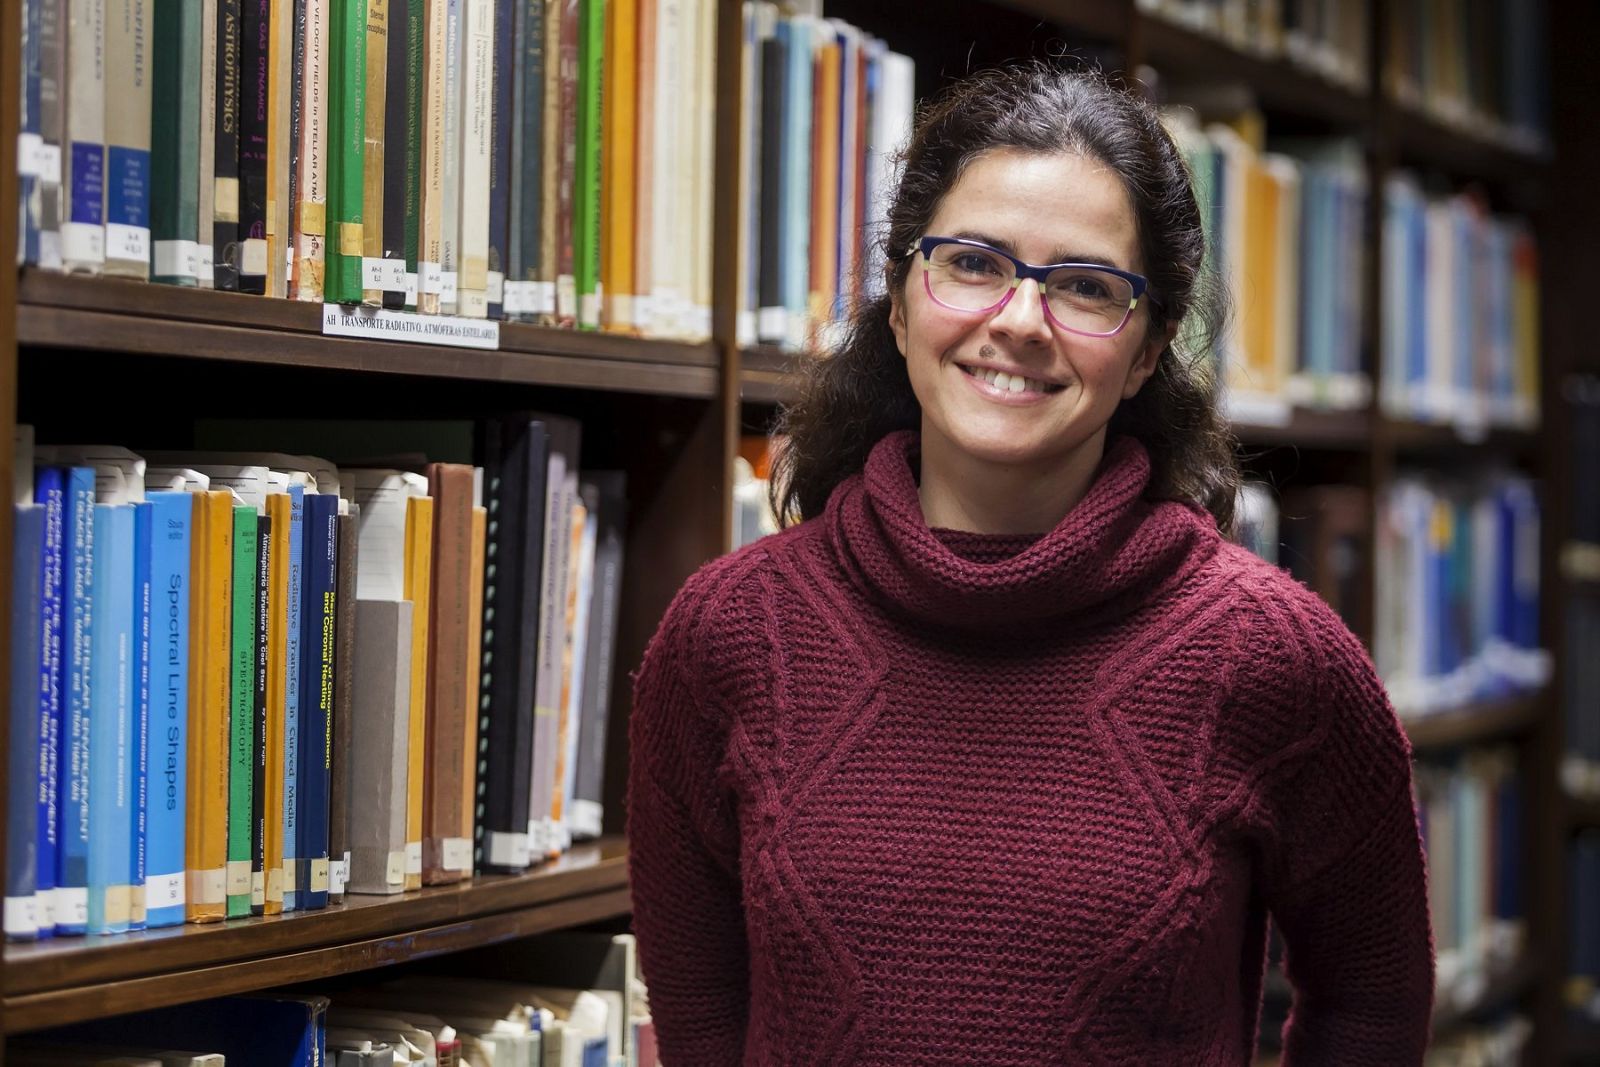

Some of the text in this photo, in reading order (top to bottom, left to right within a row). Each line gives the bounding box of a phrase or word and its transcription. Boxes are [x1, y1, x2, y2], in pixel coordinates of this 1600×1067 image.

[259, 23, 267, 49] GAS
[448, 15, 457, 65] Methods
[223, 12, 235, 133] ASTROPHYSICS
[257, 57, 265, 121] DYNAMICS
[448, 67, 456, 79] in
[312, 107, 319, 116] in
[326, 314, 336, 325] AH
[341, 315, 384, 330] TRANSPORTE
[385, 319, 423, 333] RADIATIVO.
[462, 325, 496, 339] ESTELARES
[261, 534, 269, 587] Atmospheric
[291, 564, 299, 629] Radiative
[48, 490, 62, 845] MODELING THE STELLAR ENVIRONMENT
[80, 491, 94, 842] MODELING THE STELLAR ENVIRONMENT
[320, 664, 328, 710] Heating
[327, 666, 333, 678] of
[142, 688, 148, 699] OF
[165, 573, 182, 811] Spectral Line Shapes
[238, 651, 247, 766] SPECTROSCOPY
[289, 706, 296, 718] in
[288, 727, 296, 777] Curved
[287, 785, 295, 828] Media
